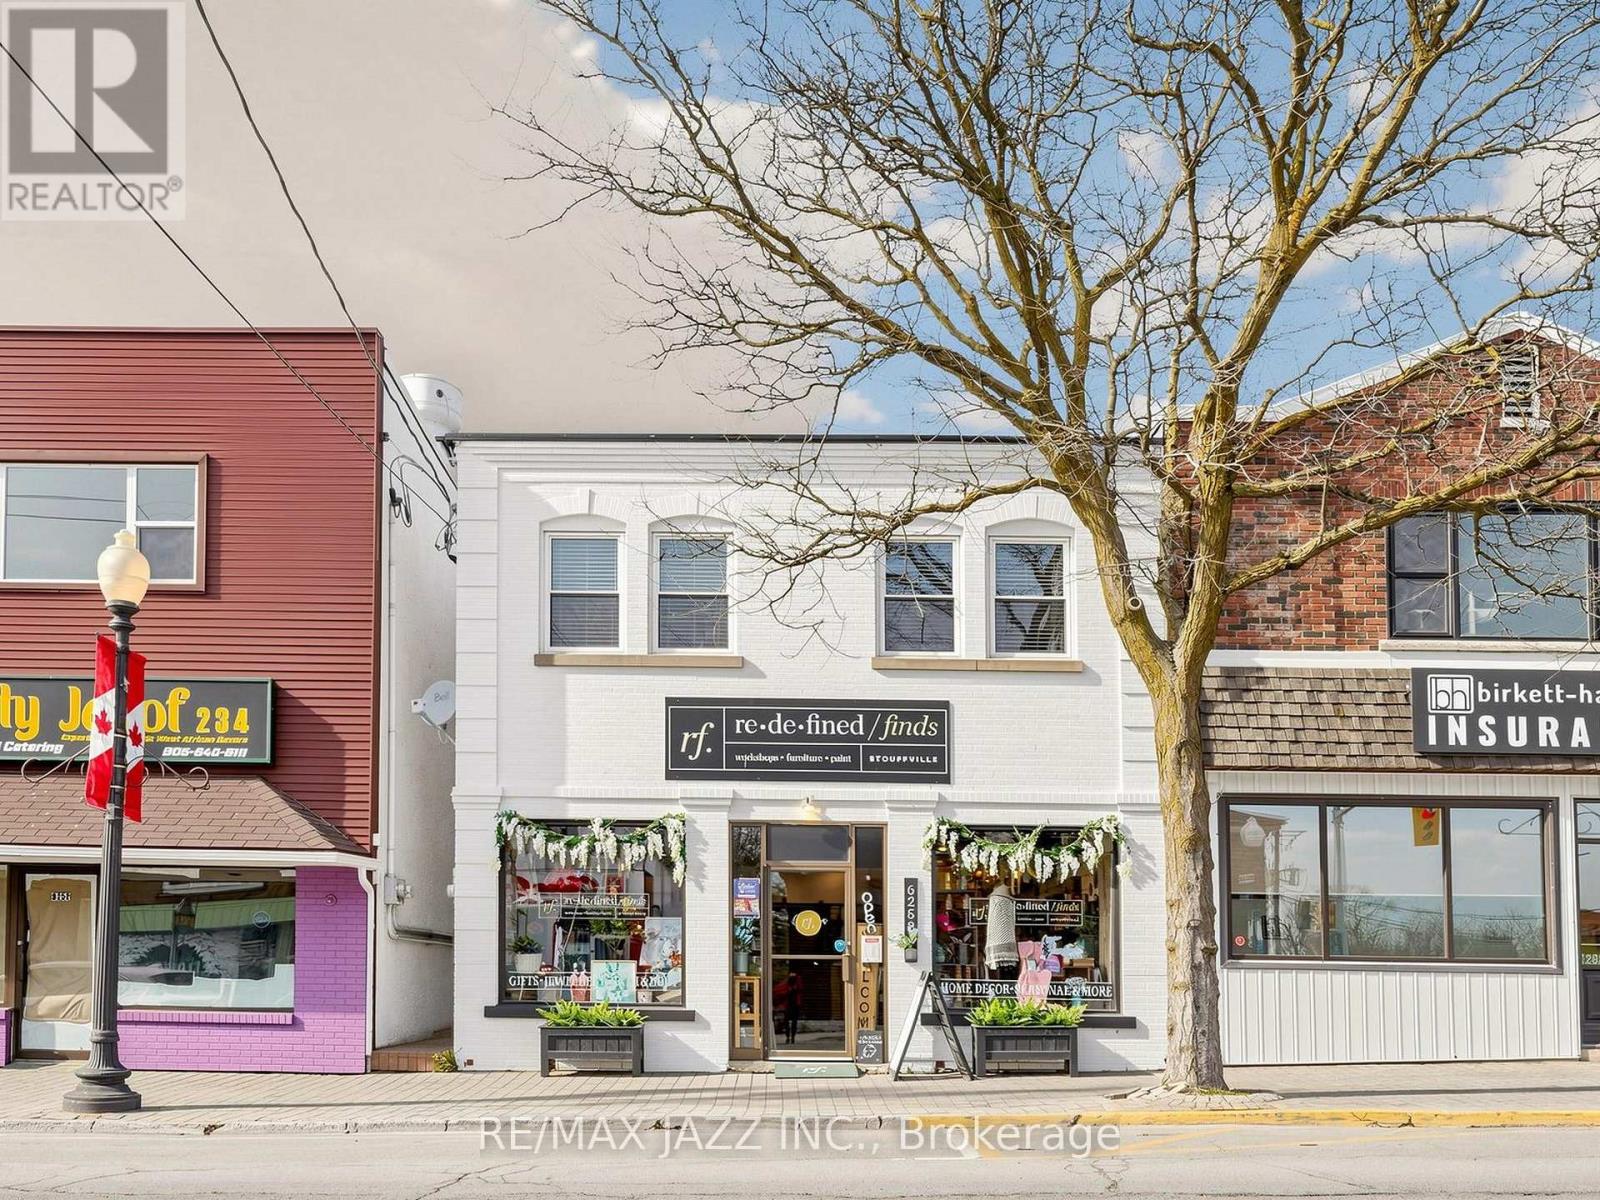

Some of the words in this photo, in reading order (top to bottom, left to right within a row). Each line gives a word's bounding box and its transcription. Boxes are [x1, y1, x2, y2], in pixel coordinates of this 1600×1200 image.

[58, 685, 191, 735] Joof
[1428, 714, 1591, 748] INSURA
[3, 741, 64, 755] Catering
[869, 755, 939, 764] STOUFFVILLE
[940, 982, 971, 994] HOME
